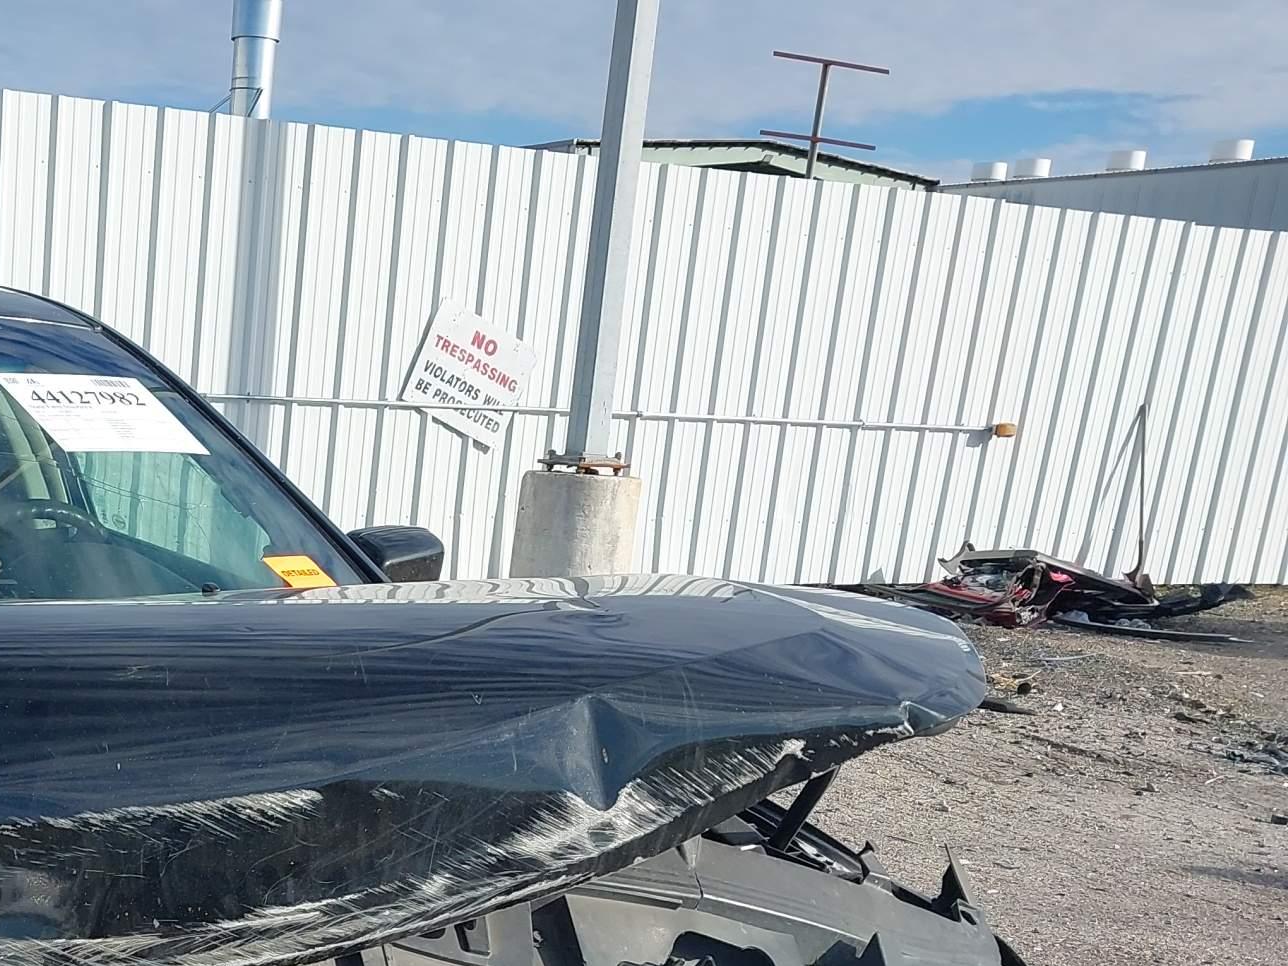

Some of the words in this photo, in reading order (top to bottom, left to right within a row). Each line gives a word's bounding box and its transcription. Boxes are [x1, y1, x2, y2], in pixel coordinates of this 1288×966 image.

[470, 329, 498, 357] NO
[433, 333, 519, 394] TRESPASSING
[414, 377, 432, 395] BE
[423, 359, 481, 401] VIOLATORS
[30, 389, 147, 407] 44127982
[280, 568, 320, 577] DETAILED
